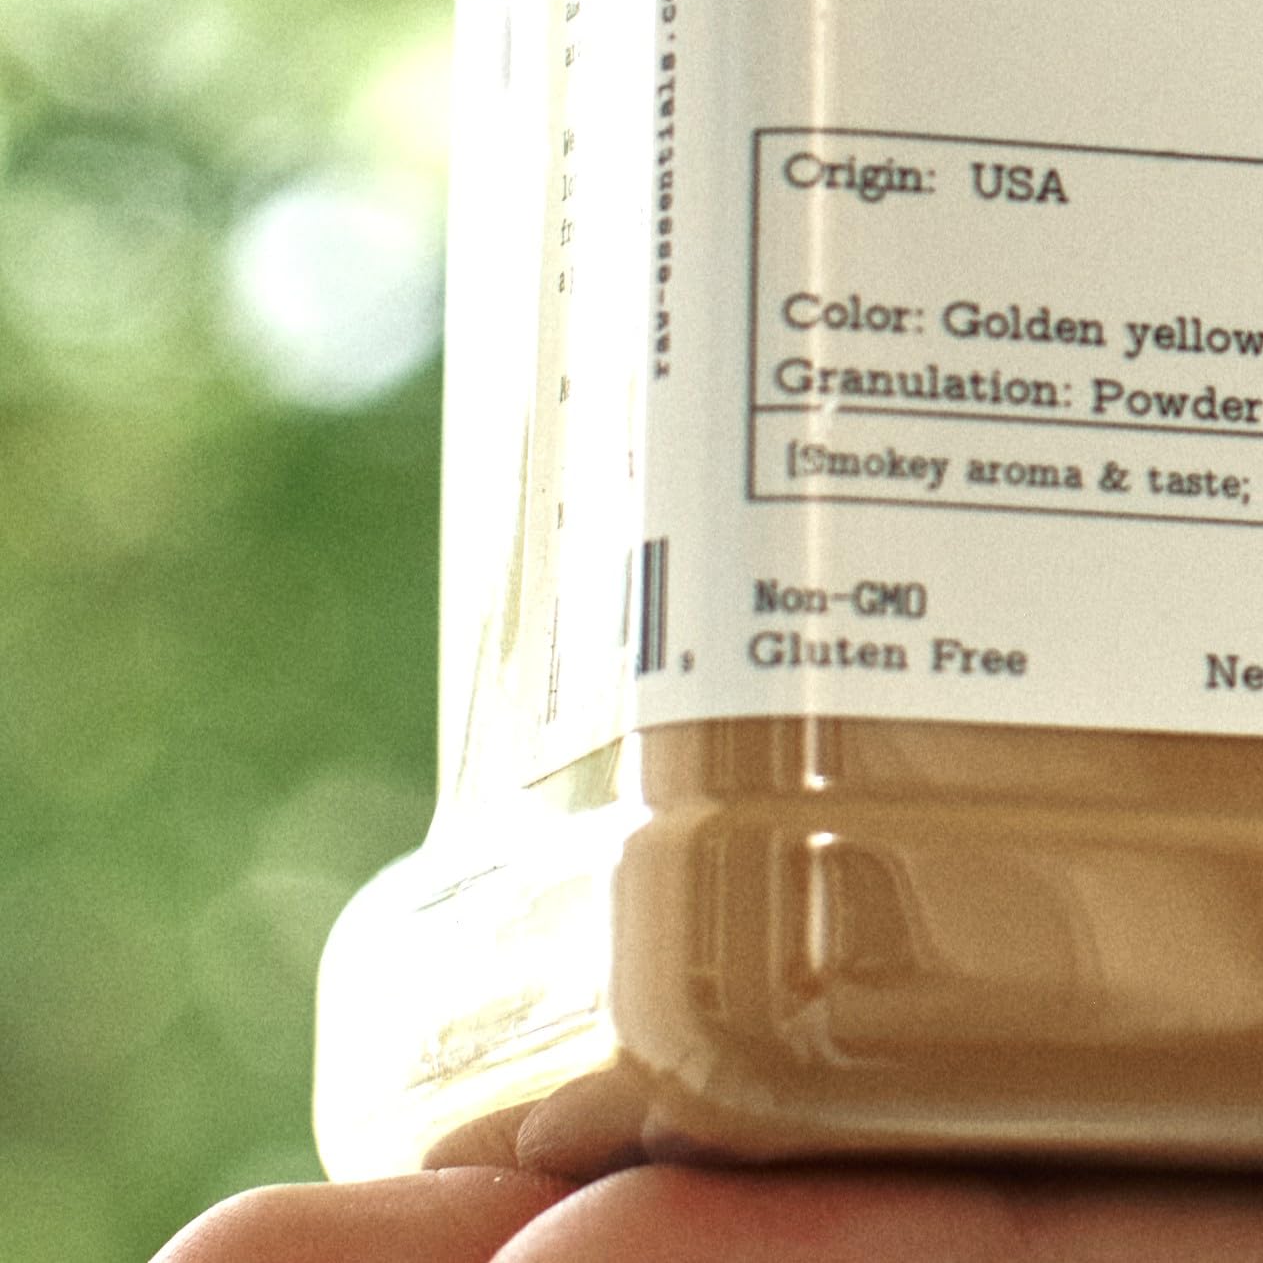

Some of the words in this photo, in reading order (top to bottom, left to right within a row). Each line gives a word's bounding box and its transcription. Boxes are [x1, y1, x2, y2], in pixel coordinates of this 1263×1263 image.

[782, 152, 936, 204] Origin:
[971, 161, 1069, 204] USA
[781, 292, 924, 335] Color:
[942, 300, 1105, 347] Golden
[774, 358, 1071, 409] Granulation:
[1090, 378, 1263, 424] Powder
[965, 460, 1083, 492] aroma
[1102, 463, 1130, 494] &
[1147, 468, 1251, 505] taste;
[754, 579, 928, 620] Non-GMO
[748, 629, 909, 673] Gluten
[931, 637, 1029, 678] Free
